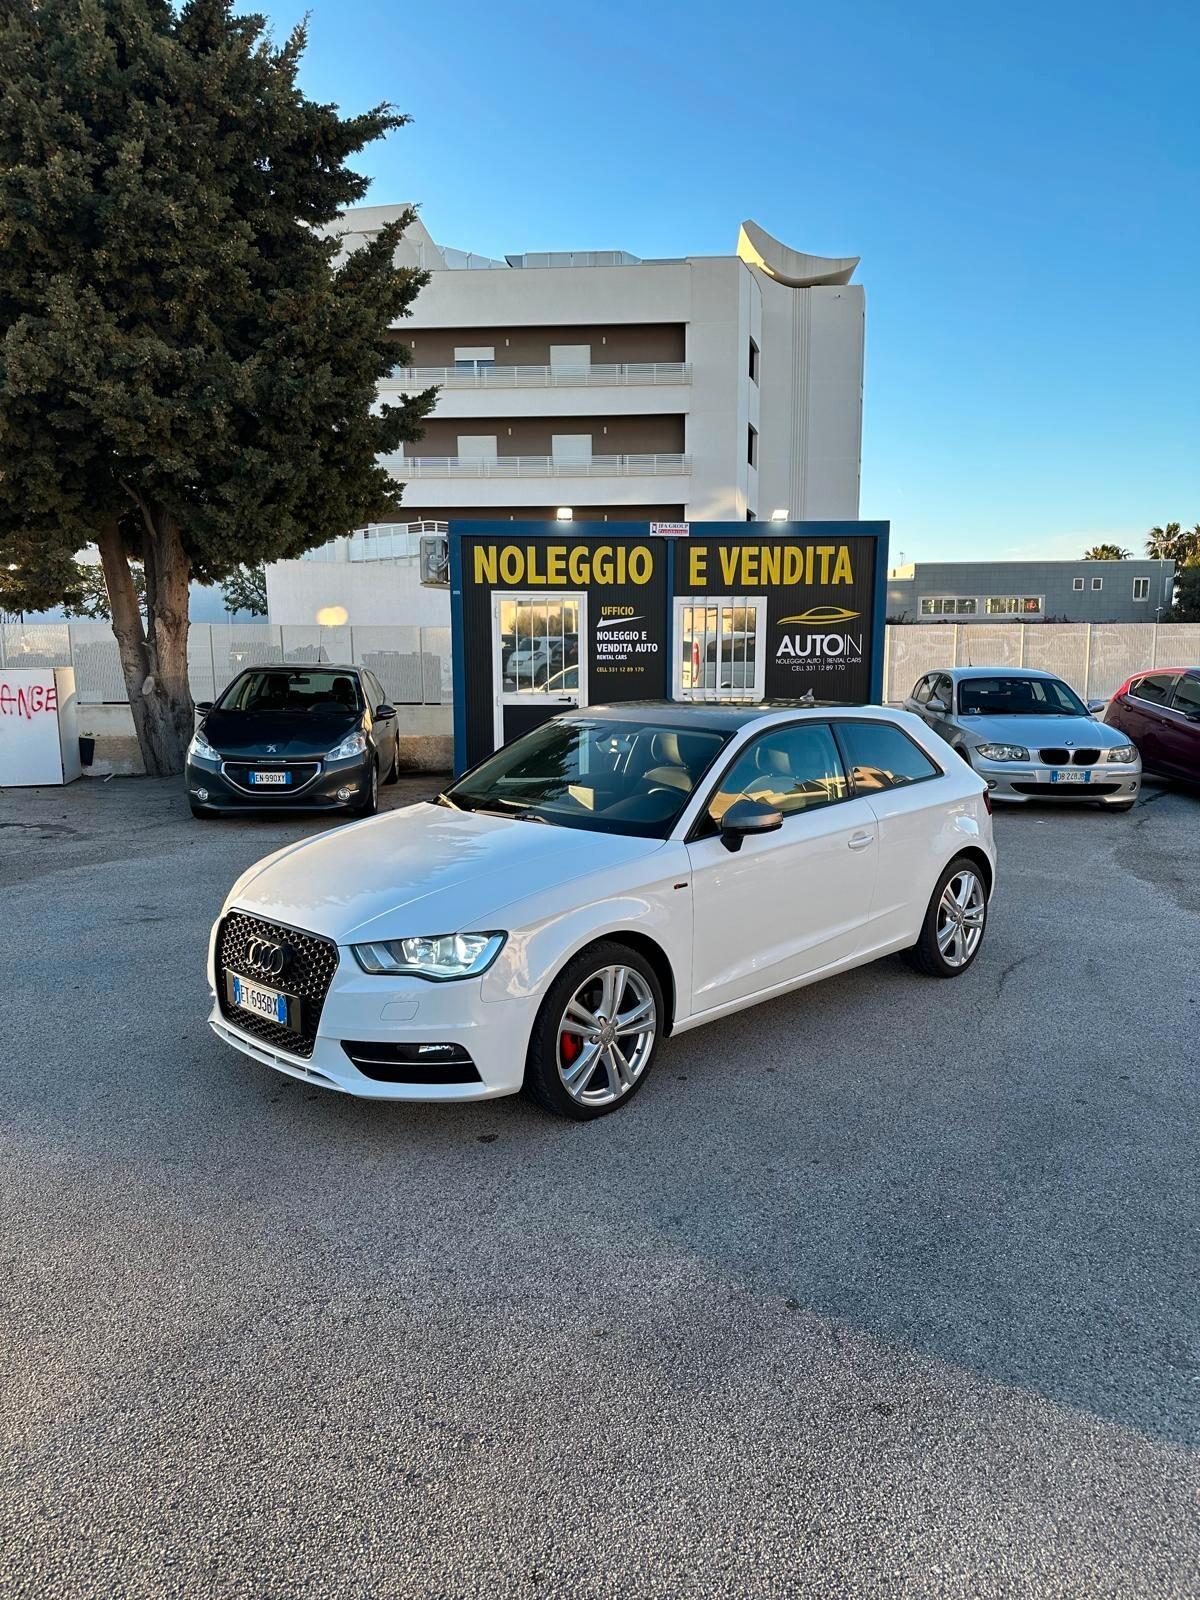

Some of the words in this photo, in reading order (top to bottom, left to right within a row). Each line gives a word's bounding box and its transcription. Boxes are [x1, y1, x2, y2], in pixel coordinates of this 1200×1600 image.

[474, 545, 653, 585] NOLEGGIO
[689, 546, 708, 586] E
[718, 545, 854, 586] VENDITA
[601, 606, 634, 616] UFFICIO
[596, 631, 639, 641] NOLEGGIO
[641, 631, 647, 640] E
[596, 643, 633, 653] VENDITA
[635, 643, 658, 653] AUTO
